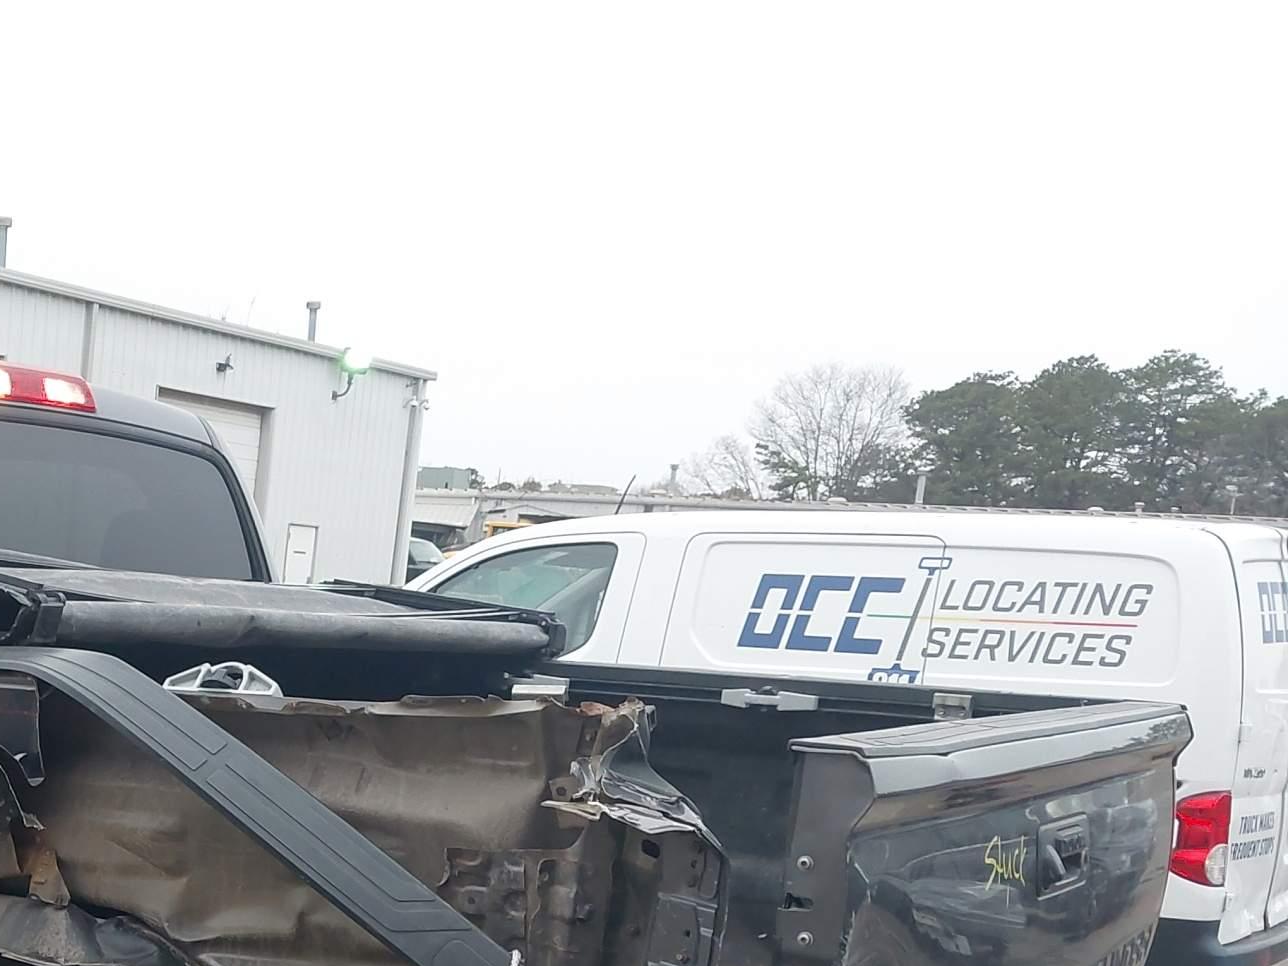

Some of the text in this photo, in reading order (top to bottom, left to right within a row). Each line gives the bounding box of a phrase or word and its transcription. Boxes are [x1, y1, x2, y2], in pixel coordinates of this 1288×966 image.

[736, 573, 906, 655] OCC
[939, 579, 1154, 617] LOCATING
[921, 627, 1133, 668] SERVICES
[1239, 814, 1257, 834] TRUCK
